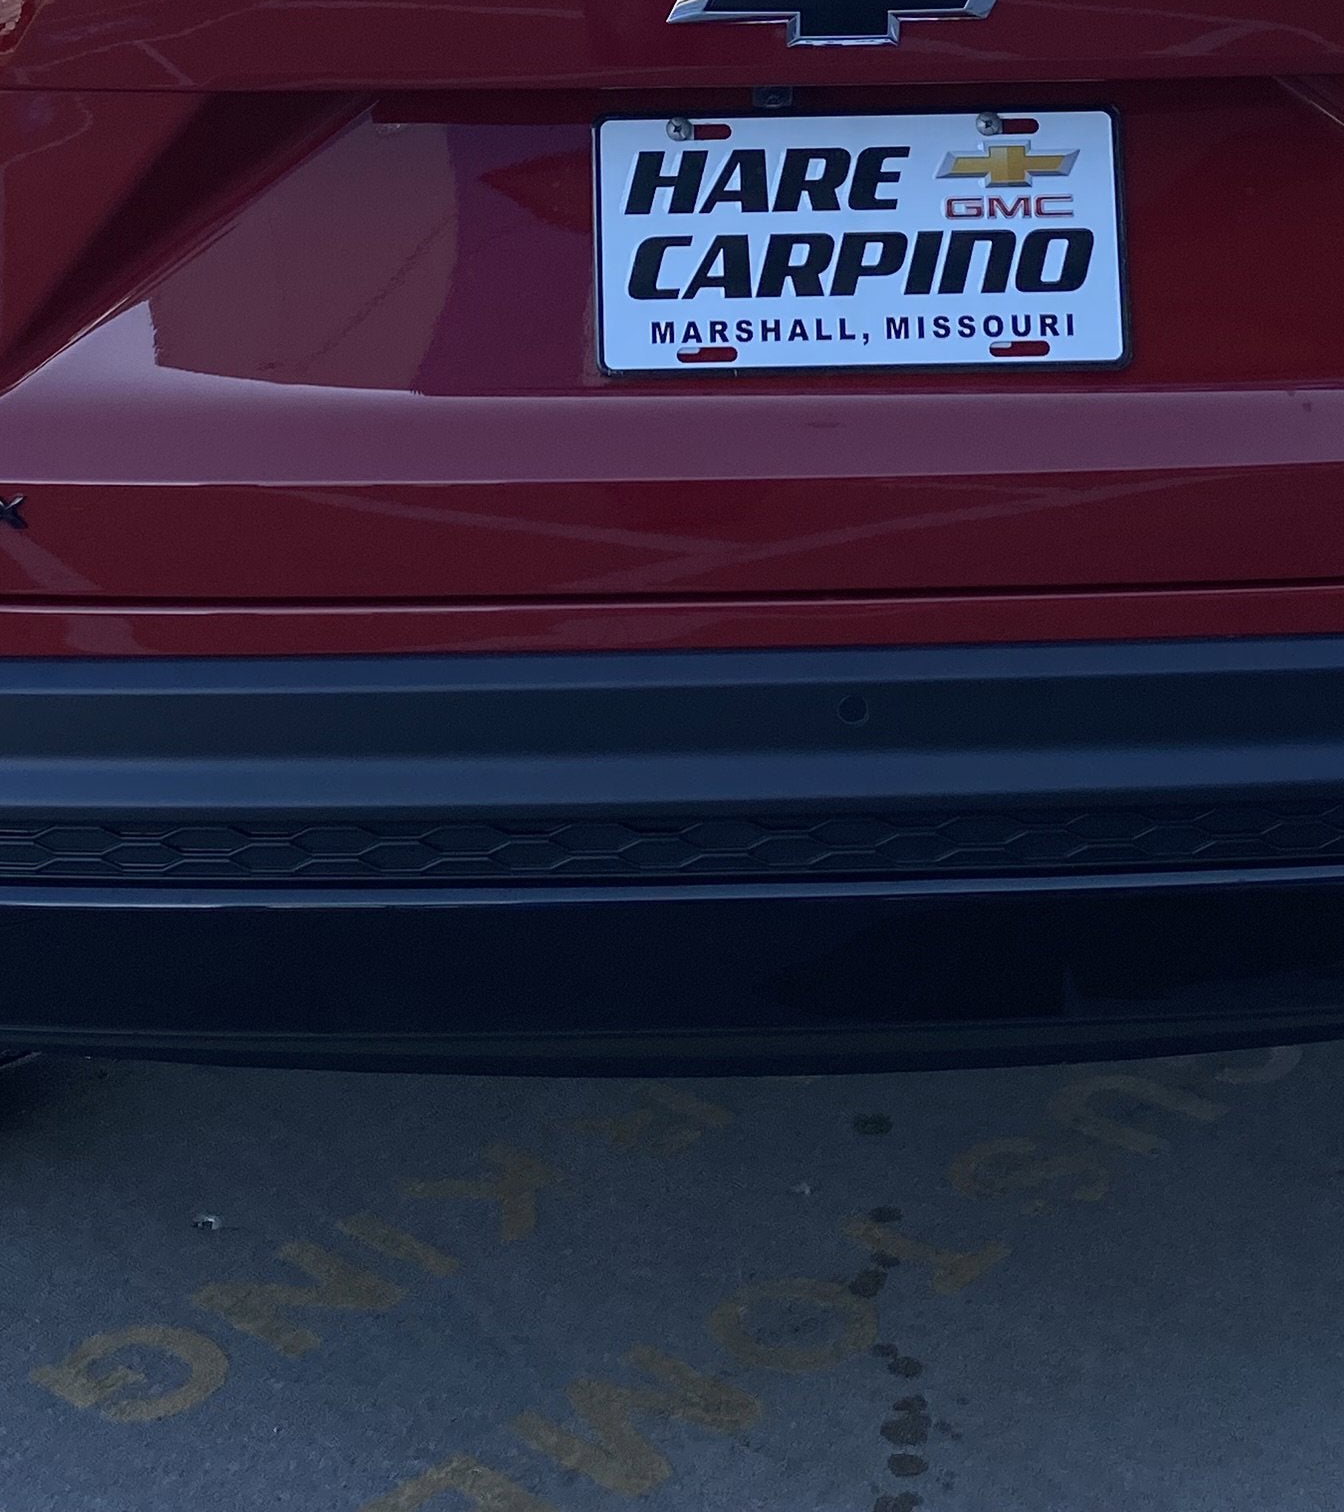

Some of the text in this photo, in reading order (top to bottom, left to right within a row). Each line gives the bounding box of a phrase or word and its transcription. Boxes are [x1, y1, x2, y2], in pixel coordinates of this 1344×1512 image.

[624, 145, 911, 216] HARE
[944, 194, 1074, 220] GMC
[627, 228, 1094, 301] CARPINO
[651, 313, 1075, 346] MARSHALL, MISSOURI
